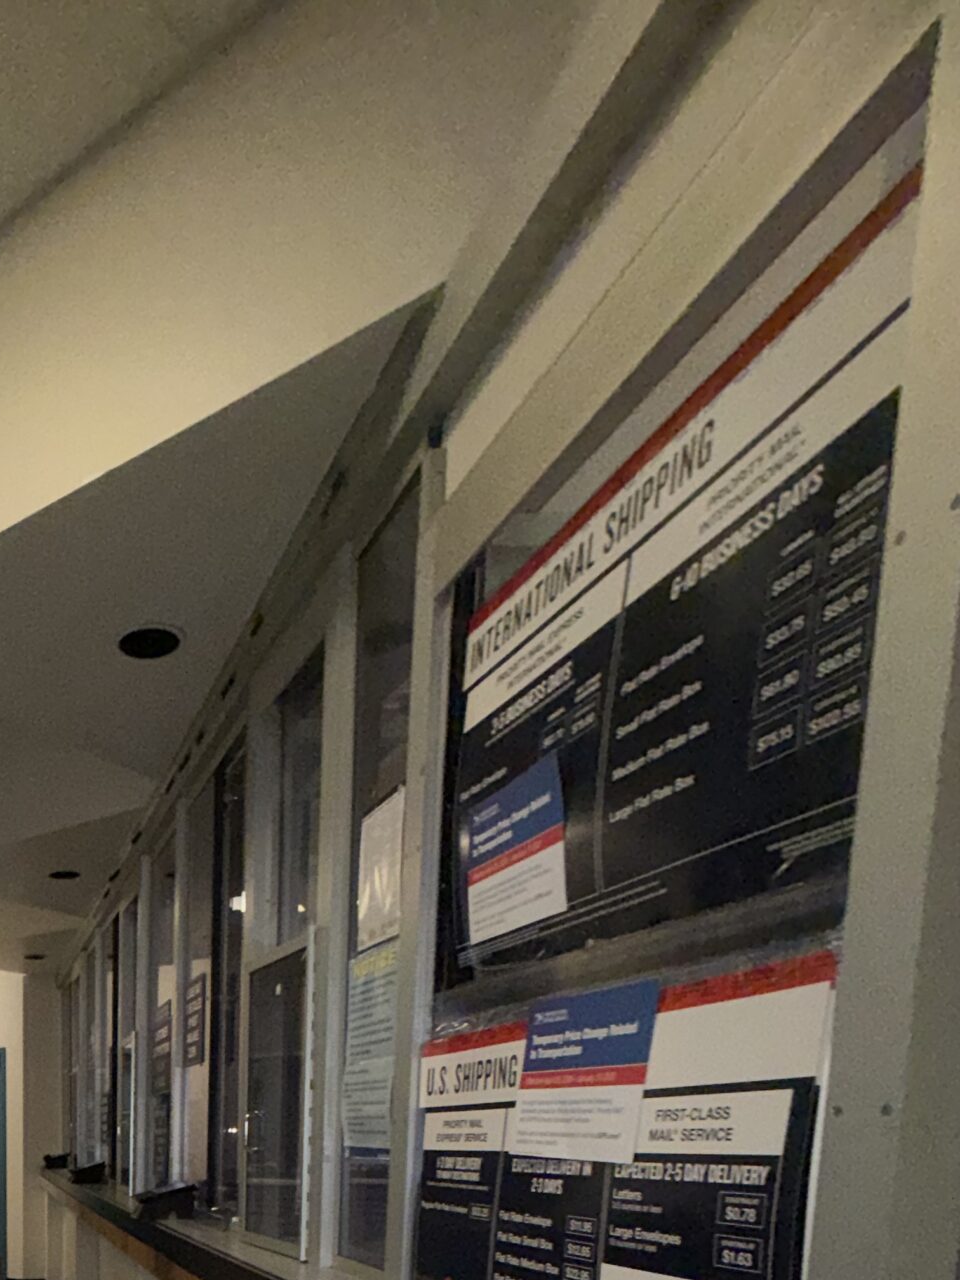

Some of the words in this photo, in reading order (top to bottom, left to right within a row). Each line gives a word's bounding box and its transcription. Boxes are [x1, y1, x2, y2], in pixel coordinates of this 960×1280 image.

[470, 536, 593, 670] INTERNATIONAL
[603, 420, 713, 552] SHIPPING
[426, 1066, 448, 1095] U.S.
[454, 1055, 517, 1092] SHIPPING
[656, 1106, 730, 1121] FIRST-CLASS
[680, 1127, 732, 1141] SERVICE
[614, 1161, 663, 1179] EXPECTED
[663, 1162, 682, 1180] 2-5
[683, 1163, 706, 1181] DAY
[707, 1164, 768, 1184] DELIVERY
[725, 1207, 756, 1222] $0.78
[608, 1224, 633, 1239] Large
[634, 1227, 681, 1245] Envelopes
[721, 1249, 752, 1266] $1.63
